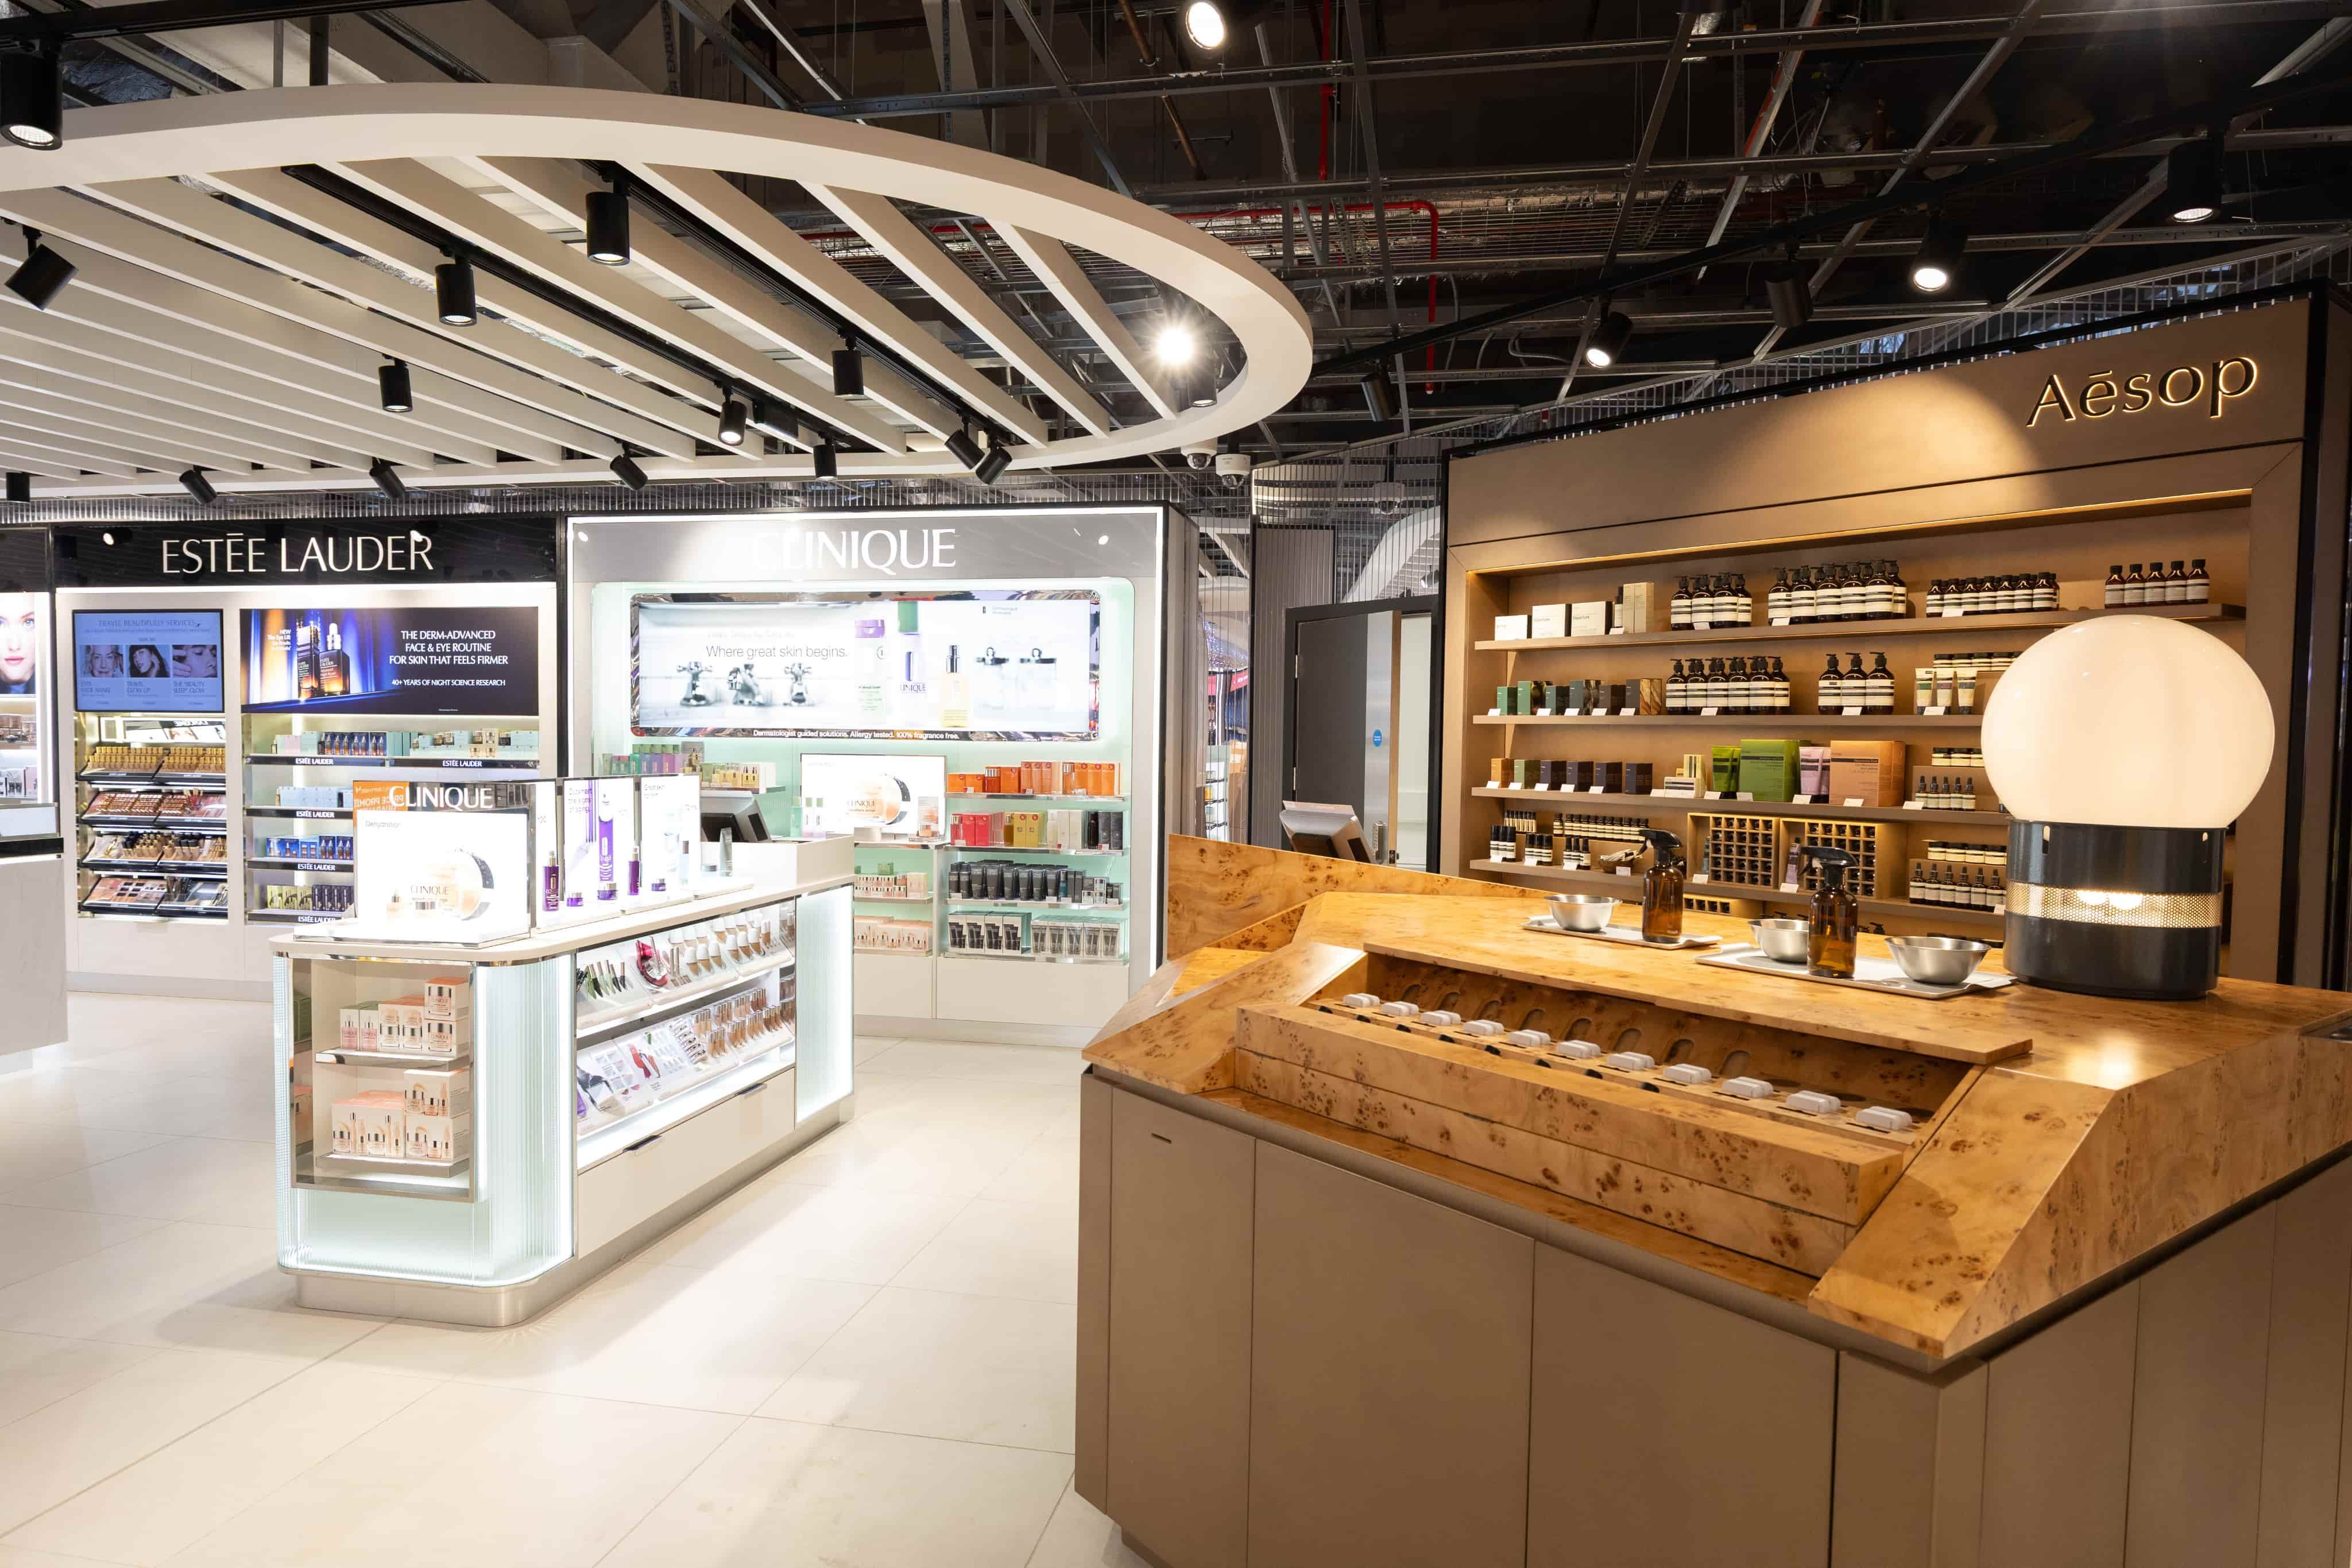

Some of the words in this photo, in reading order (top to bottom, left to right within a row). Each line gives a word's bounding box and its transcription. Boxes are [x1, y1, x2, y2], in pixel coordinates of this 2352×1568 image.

[281, 535, 434, 572] LAUDER
[751, 528, 957, 575] CLINIQUE
[401, 630, 418, 640] THE
[420, 630, 496, 640] DERM-ADVANCED
[405, 643, 425, 652] FACE
[427, 643, 434, 652] &
[436, 643, 450, 652] EYE
[452, 643, 492, 652] ROUTINE
[706, 645, 744, 657] Where
[746, 647, 776, 660] great
[779, 645, 803, 657] skin
[806, 646, 848, 660] begins.
[389, 656, 407, 664] FOR
[409, 656, 428, 664] SKIN
[430, 656, 451, 664] THAT
[453, 656, 475, 664] FEELS
[478, 656, 508, 664] FIRMER
[797, 730, 818, 738] guided
[850, 730, 871, 738] Allergy
[914, 731, 943, 740] fragrance
[389, 785, 493, 812] CLINIQUE
[846, 800, 876, 808] CLINIQUE
[411, 886, 450, 895] CLINIQUE
